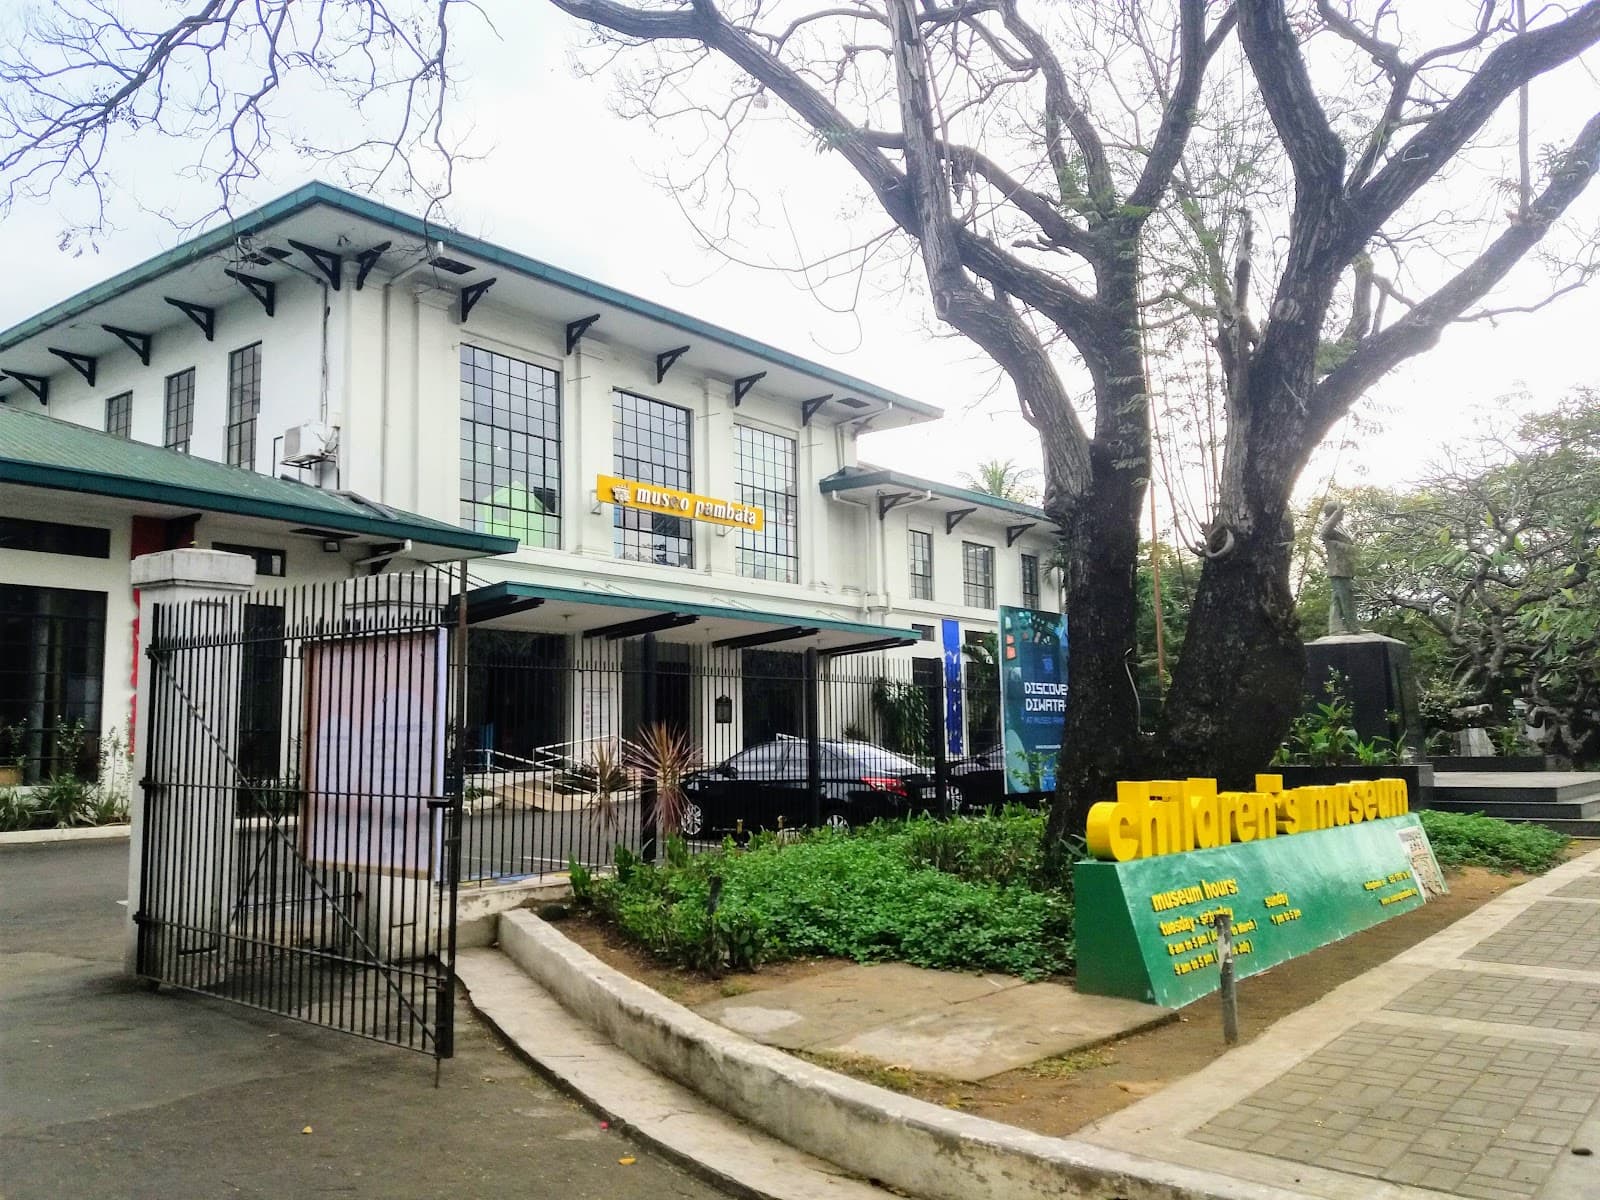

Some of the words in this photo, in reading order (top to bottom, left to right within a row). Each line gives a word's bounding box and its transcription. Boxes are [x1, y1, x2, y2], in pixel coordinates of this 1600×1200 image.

[636, 486, 689, 511] museo
[694, 499, 756, 525] pambata
[1024, 682, 1068, 695] DISCOVE
[1086, 773, 1301, 862] children's
[1302, 778, 1409, 832] museum
[1151, 886, 1204, 911] museum
